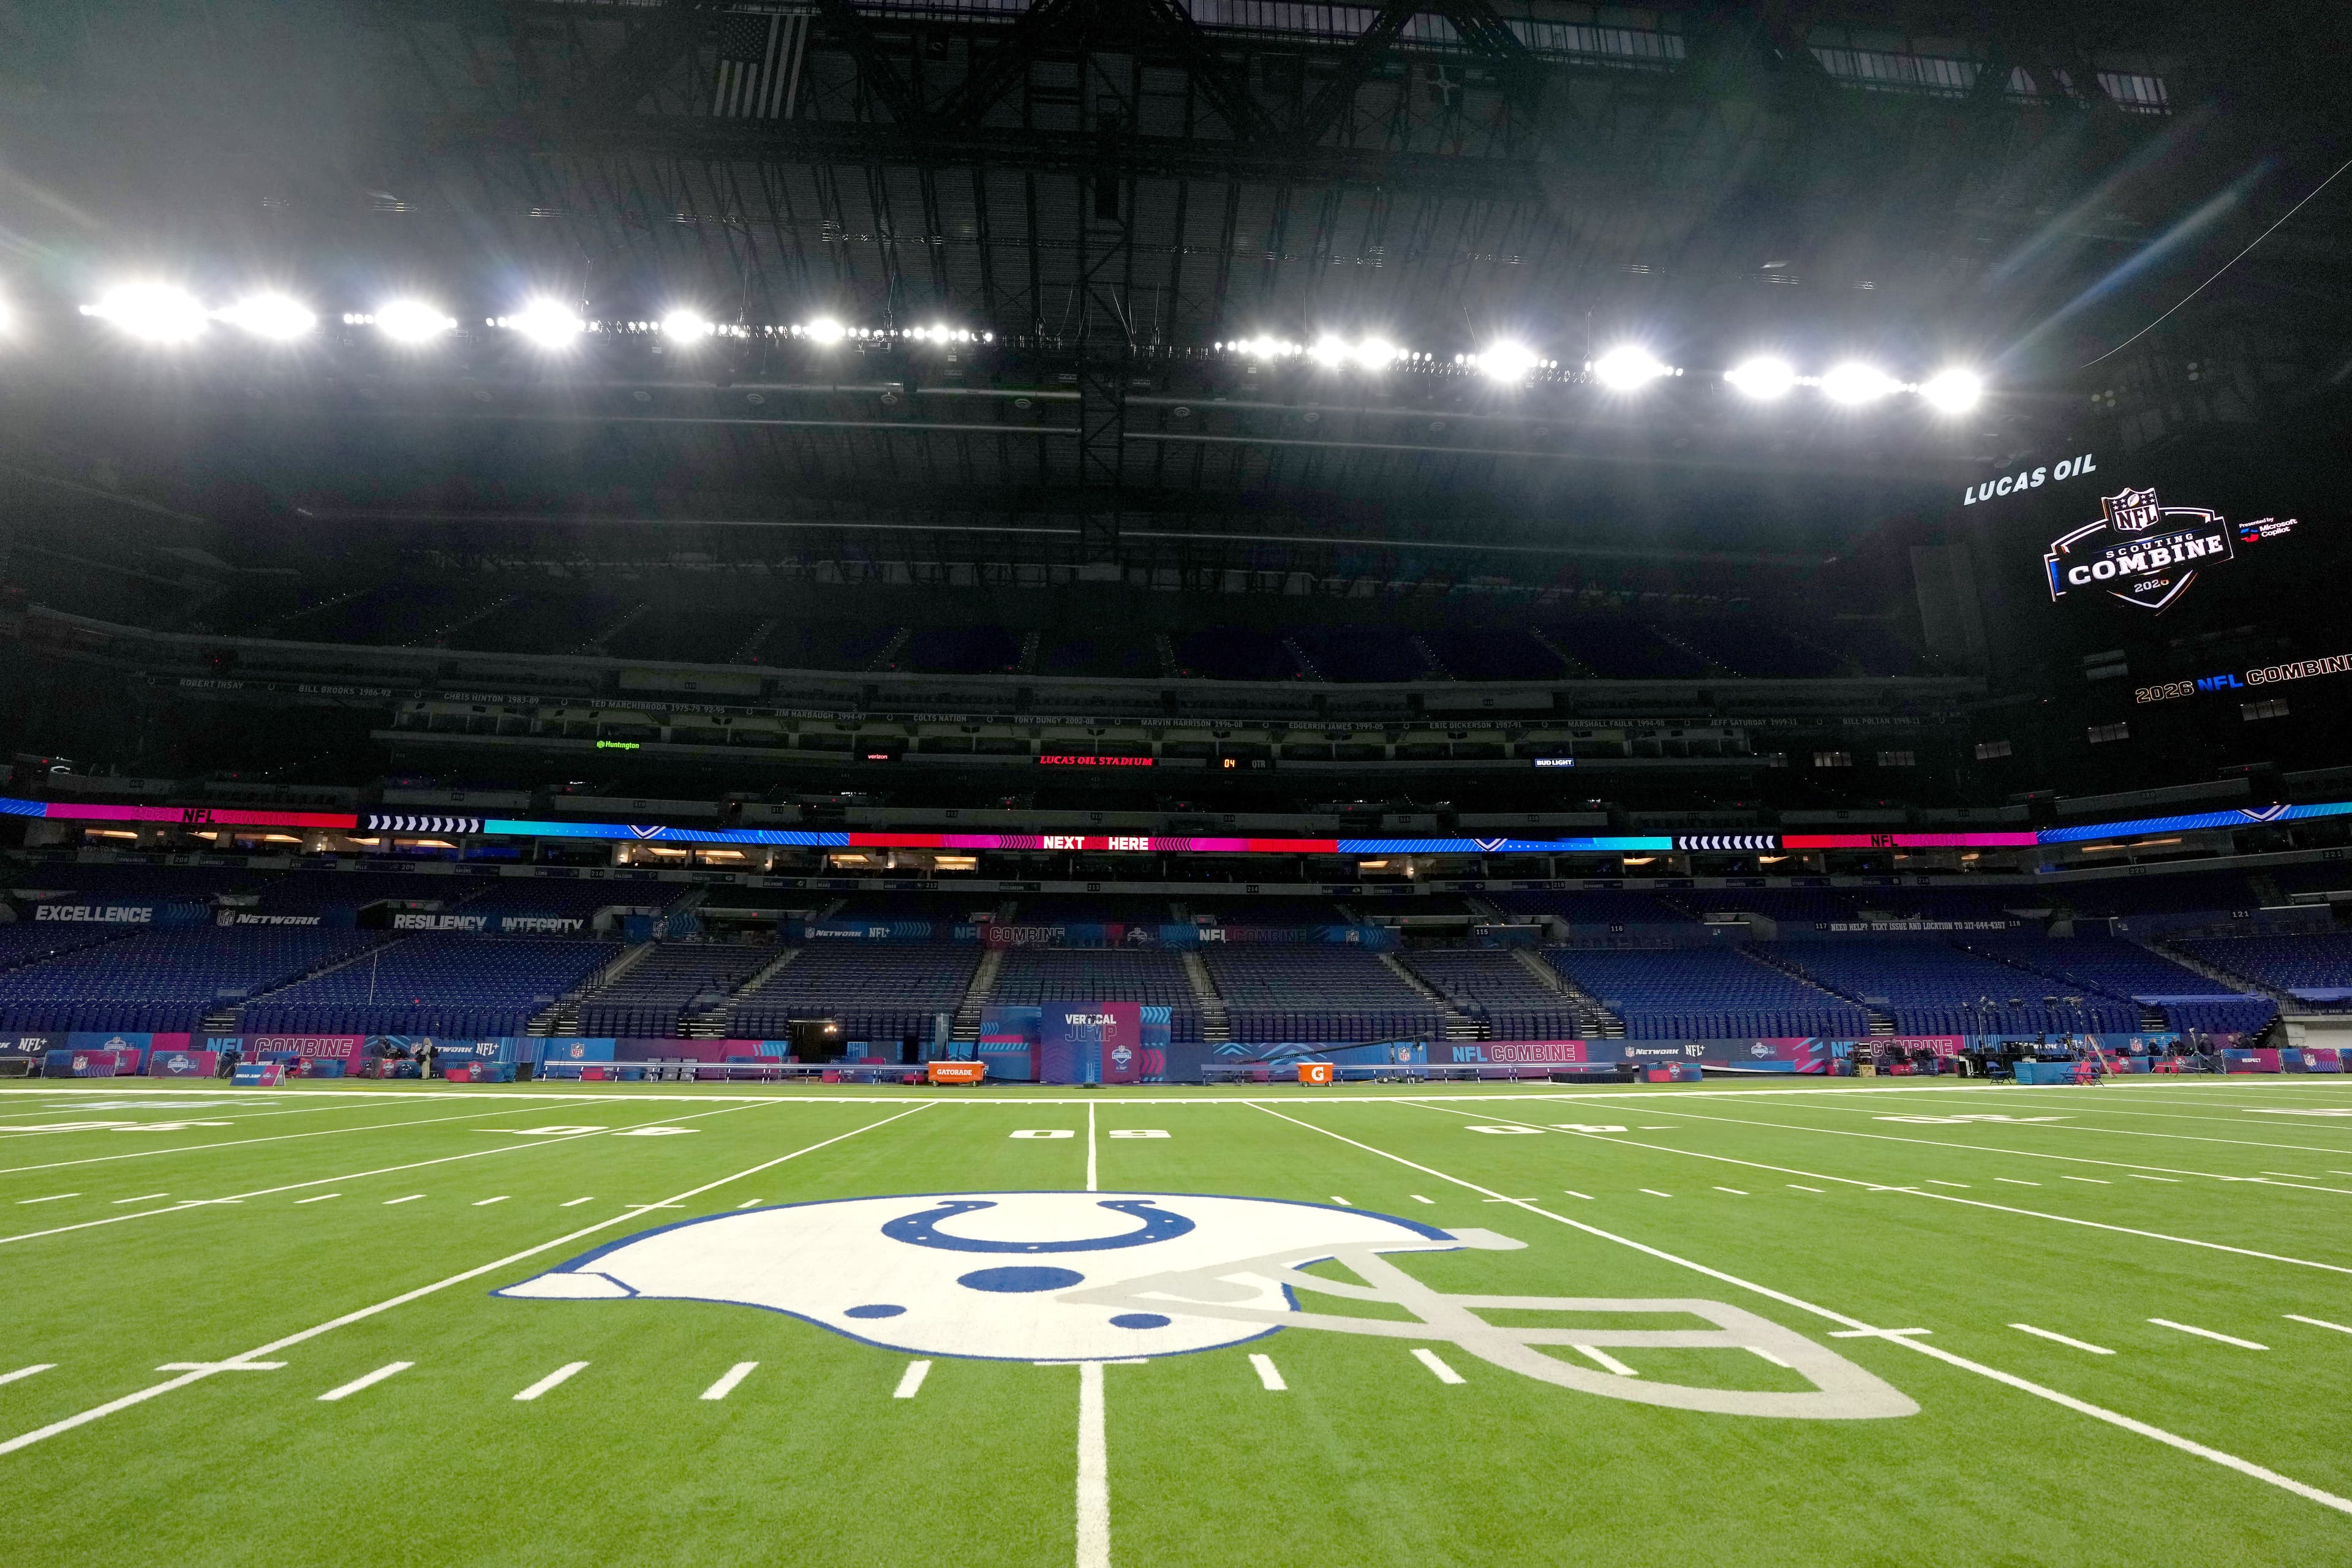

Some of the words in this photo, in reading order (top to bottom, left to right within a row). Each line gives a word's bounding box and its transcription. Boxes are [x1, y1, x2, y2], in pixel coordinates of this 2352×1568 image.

[1964, 467, 2046, 506] LUCAS
[2054, 453, 2097, 481] OIL
[2239, 518, 2266, 528] Presented
[2260, 518, 2297, 532] Microsoft
[2261, 526, 2290, 537] Copilot
[2106, 533, 2194, 559] SCOUTING
[2068, 535, 2223, 585] COMBINE
[321, 686, 355, 695] BROOKS
[2135, 681, 2194, 703] 2026
[2198, 674, 2243, 692] NFL
[444, 693, 470, 701] CHRIS
[472, 693, 503, 703] HINTON
[609, 701, 667, 711] MARCHIBRODA
[791, 710, 834, 720] HARBAUGH
[913, 714, 937, 722] COLTS
[938, 714, 967, 723] NATION
[1036, 717, 1061, 725] DUNGY
[1730, 718, 1766, 727] SATURDAY
[605, 741, 639, 750] Huntington
[1040, 755, 1076, 765] LUCAS
[1078, 756, 1096, 765] OIL
[1099, 756, 1153, 766] STADIUM
[1224, 758, 1235, 769] 04
[1252, 760, 1266, 768] QTR
[130, 807, 179, 821] 2026
[184, 809, 215, 823] NFL
[219, 811, 299, 826] COMBINE
[1043, 836, 1085, 850] NEXT
[1109, 837, 1148, 850] HERE
[1871, 835, 1898, 847] NFL
[35, 905, 153, 922] EXCELLENCE
[236, 914, 320, 925] NETWORK
[394, 914, 487, 931] RESILIENCY
[502, 918, 583, 932] INTEGRITY
[990, 927, 1065, 942] COMBINE
[1199, 929, 1230, 943] NFL
[1065, 1014, 1117, 1024] VERTCAL
[18, 1038, 47, 1052] NFL+
[254, 1038, 353, 1057] COMBINE
[476, 1042, 499, 1056] NFL+
[1685, 1045, 1706, 1057] NFL+
[1831, 1041, 1853, 1057] NF
[1453, 1046, 1488, 1061] NFL
[1491, 1045, 1576, 1061] COMBINE
[1311, 1066, 1324, 1081] G
